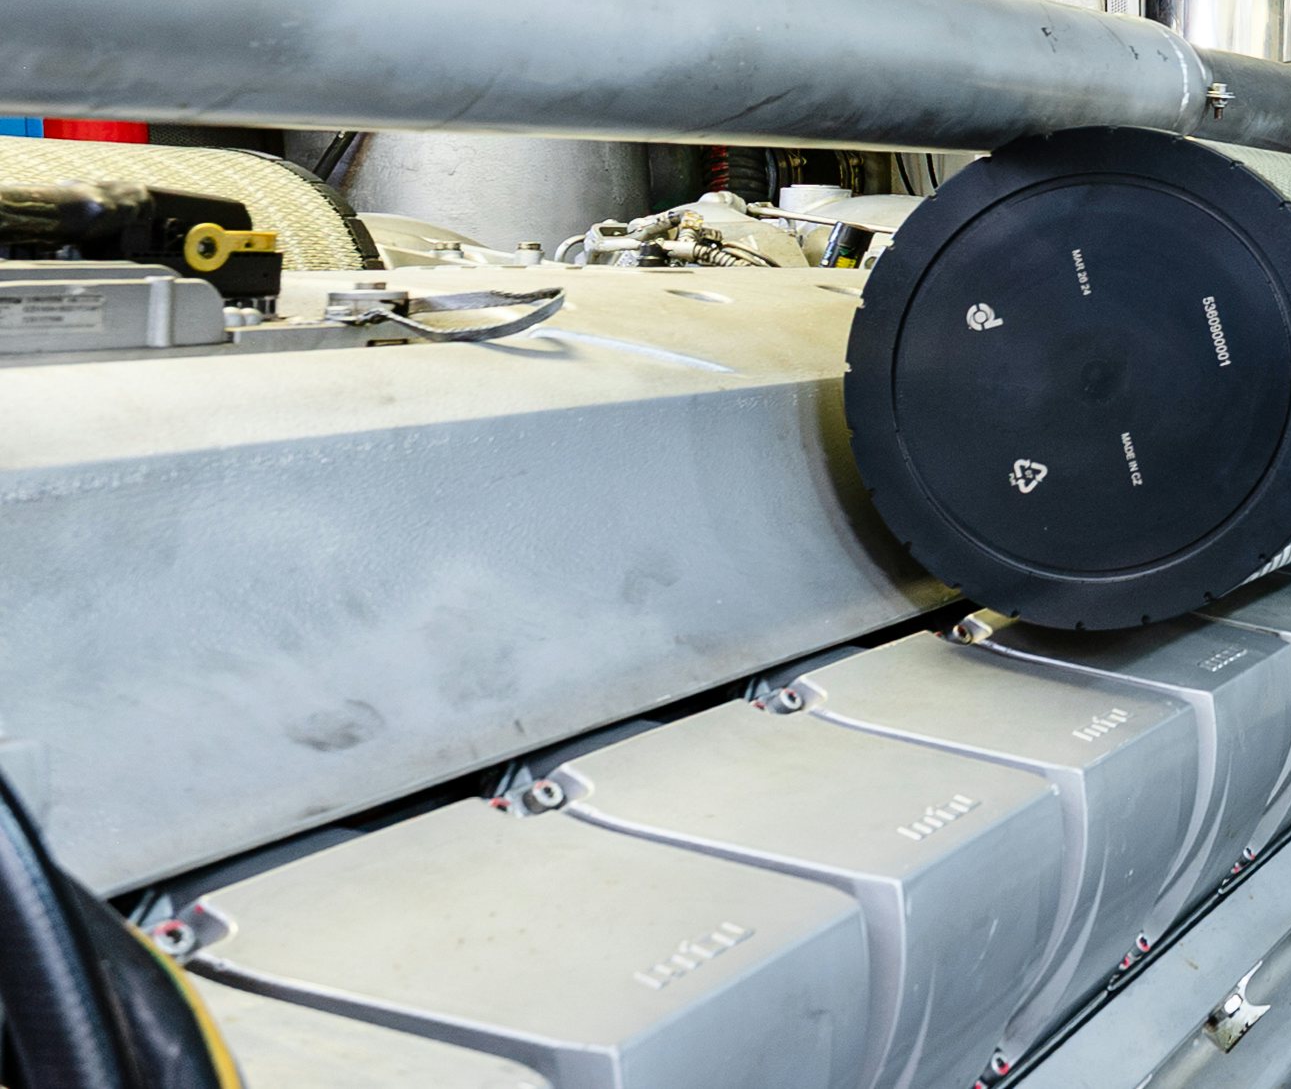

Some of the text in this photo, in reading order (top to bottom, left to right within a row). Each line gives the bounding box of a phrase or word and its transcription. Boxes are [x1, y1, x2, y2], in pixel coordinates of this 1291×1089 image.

[1072, 249, 1091, 296] MAR 20 24
[1121, 432, 1143, 486] MADE IN CZ
